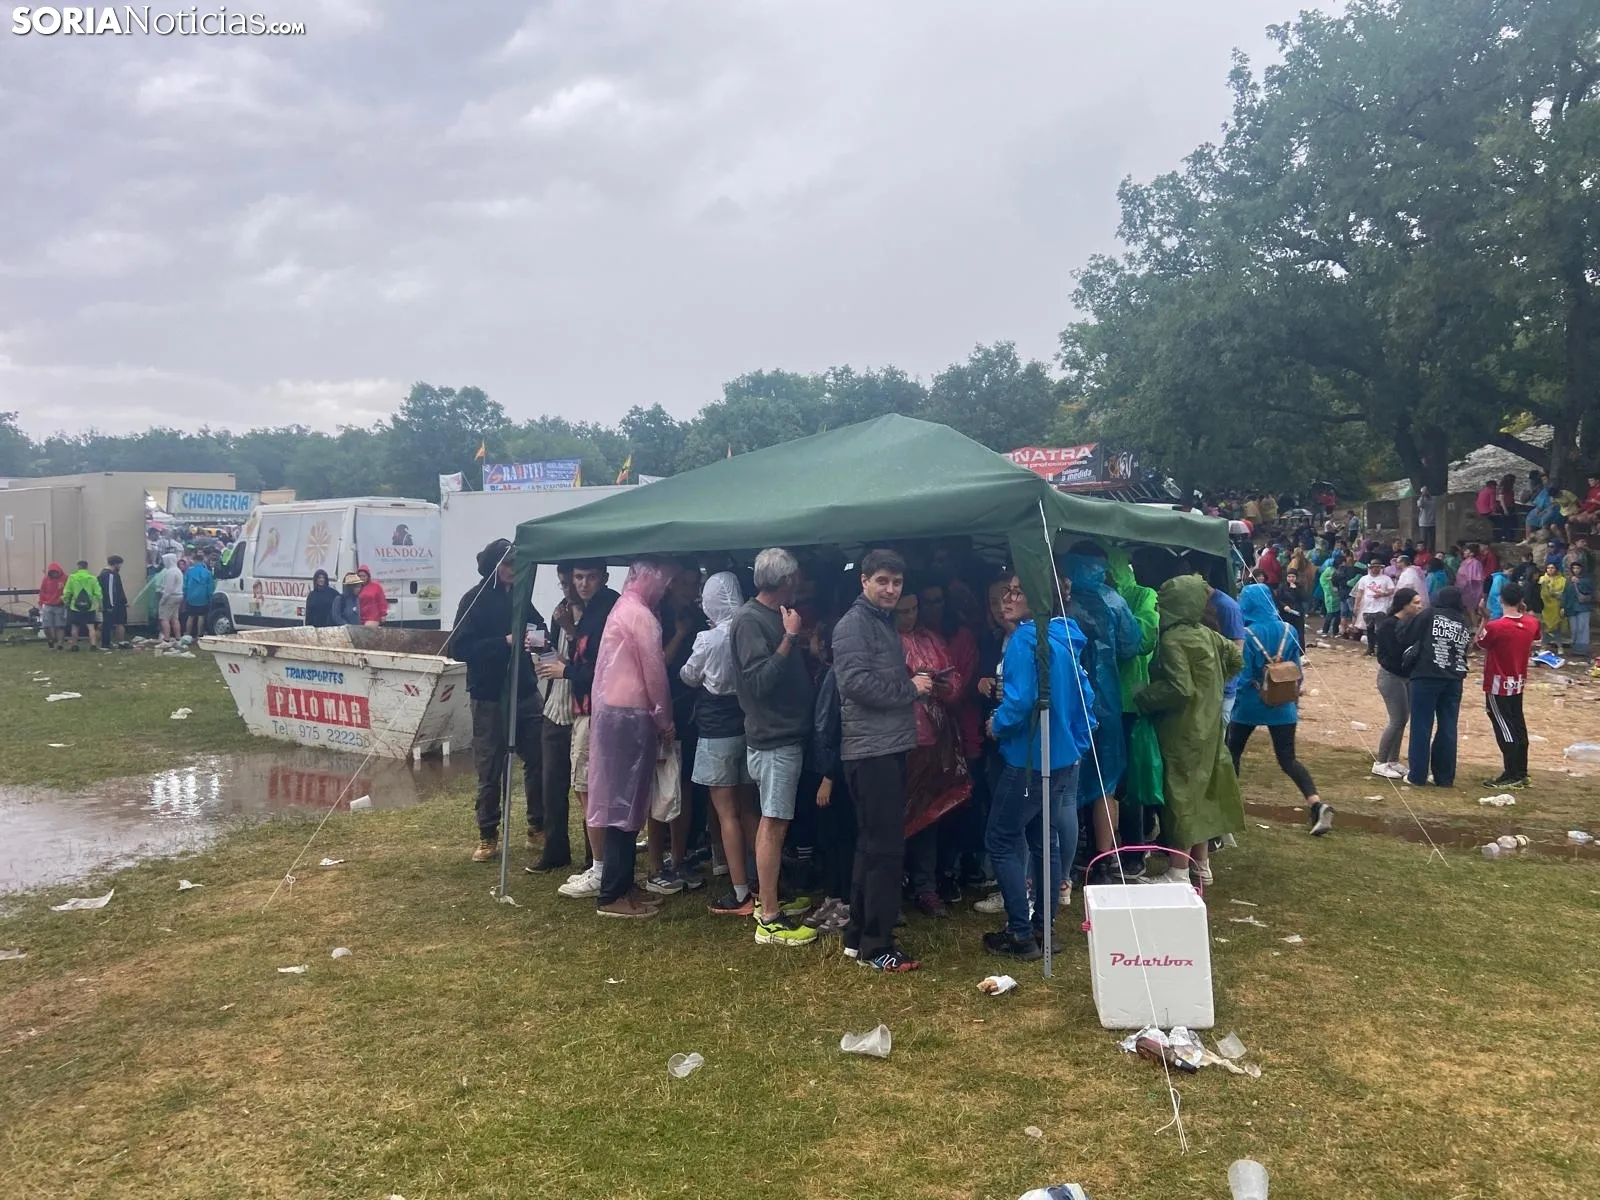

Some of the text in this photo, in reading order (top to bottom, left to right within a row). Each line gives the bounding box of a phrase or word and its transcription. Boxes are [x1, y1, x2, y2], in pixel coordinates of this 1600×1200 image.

[182, 492, 250, 511] CHURRERIA
[375, 547, 433, 558] MENDOZA
[285, 666, 344, 685] TRANSPORTES
[275, 691, 362, 724] PALOMAR
[300, 724, 320, 740] 975
[1109, 952, 1194, 967] Polarbox
